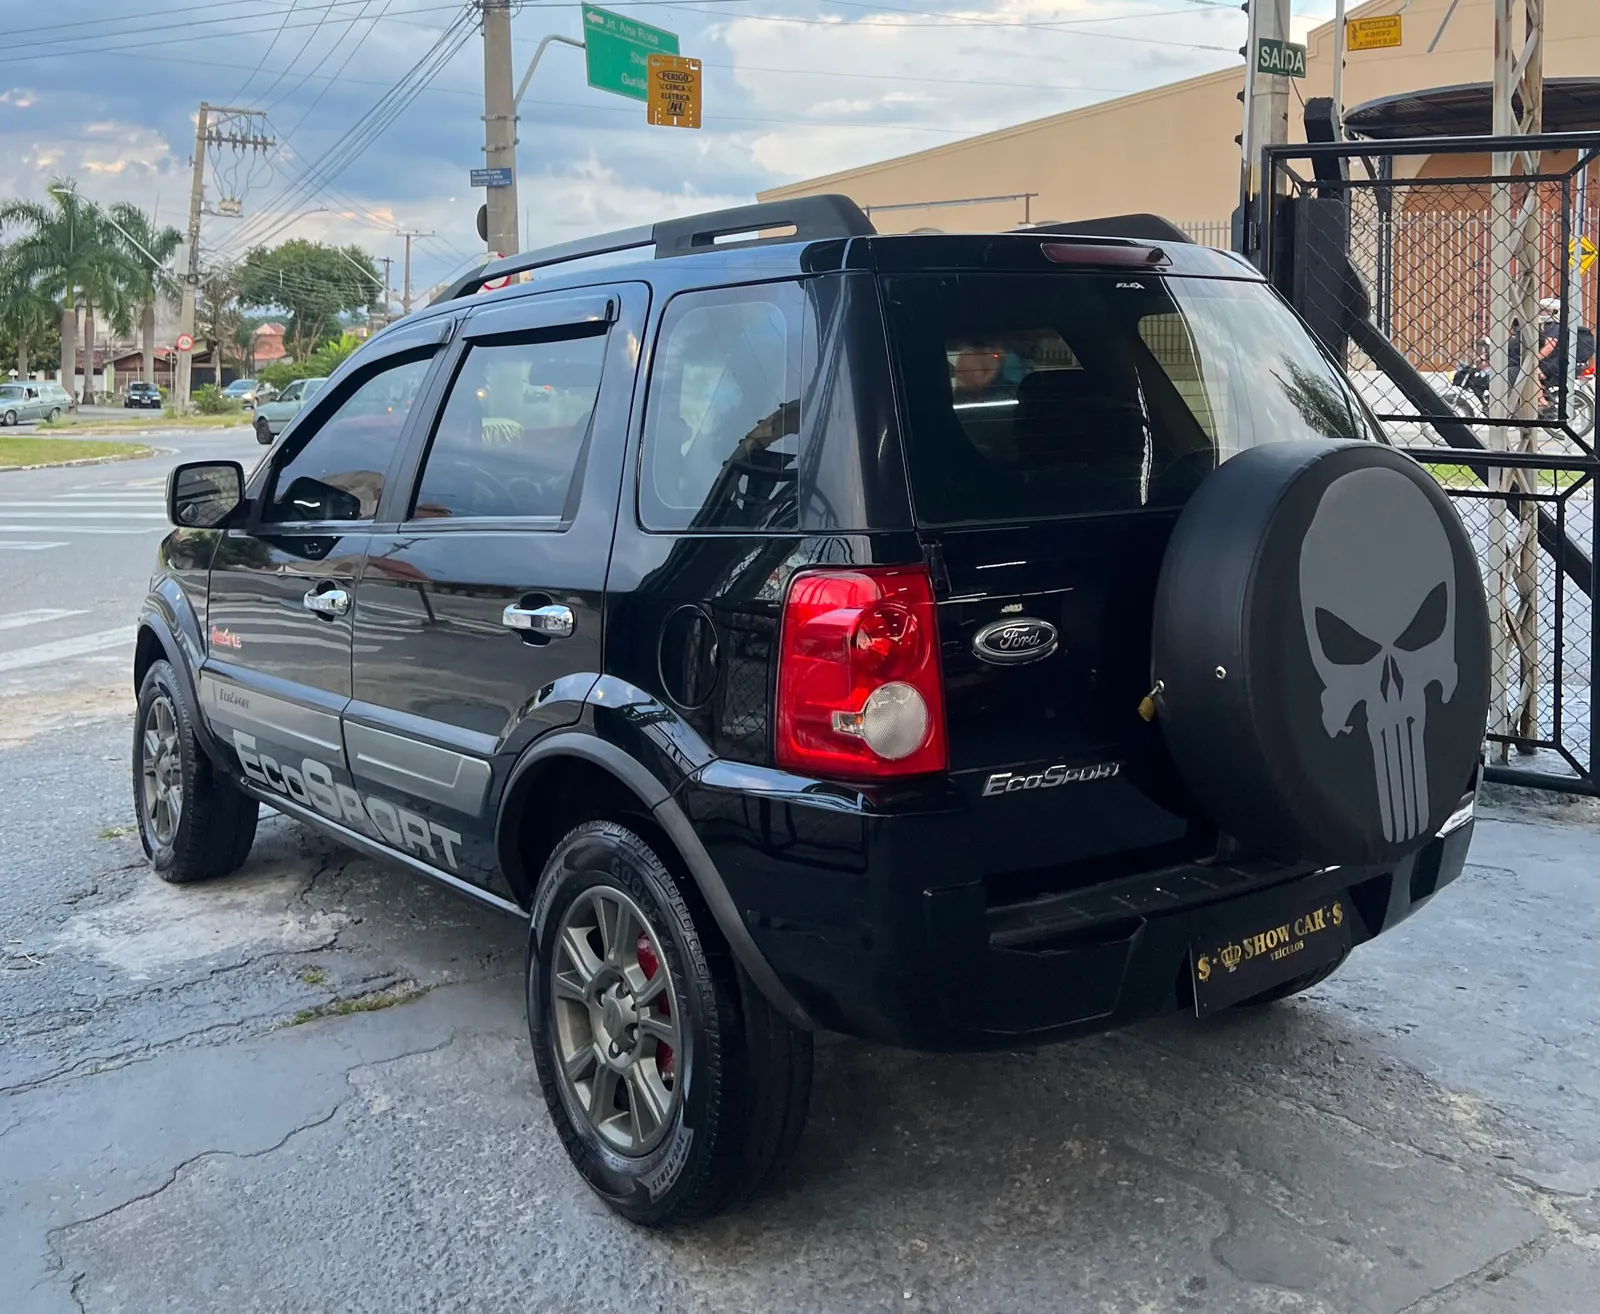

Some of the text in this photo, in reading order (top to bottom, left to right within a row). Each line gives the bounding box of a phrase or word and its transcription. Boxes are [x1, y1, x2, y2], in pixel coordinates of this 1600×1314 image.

[620, 21, 636, 37] Ana
[638, 28, 658, 44] Rosa
[662, 72, 689, 82] PERIGO
[665, 84, 686, 92] CERCA
[661, 92, 690, 101] ELÉTRICA
[999, 626, 1041, 650] Ford
[1242, 924, 1290, 960] SHOW
